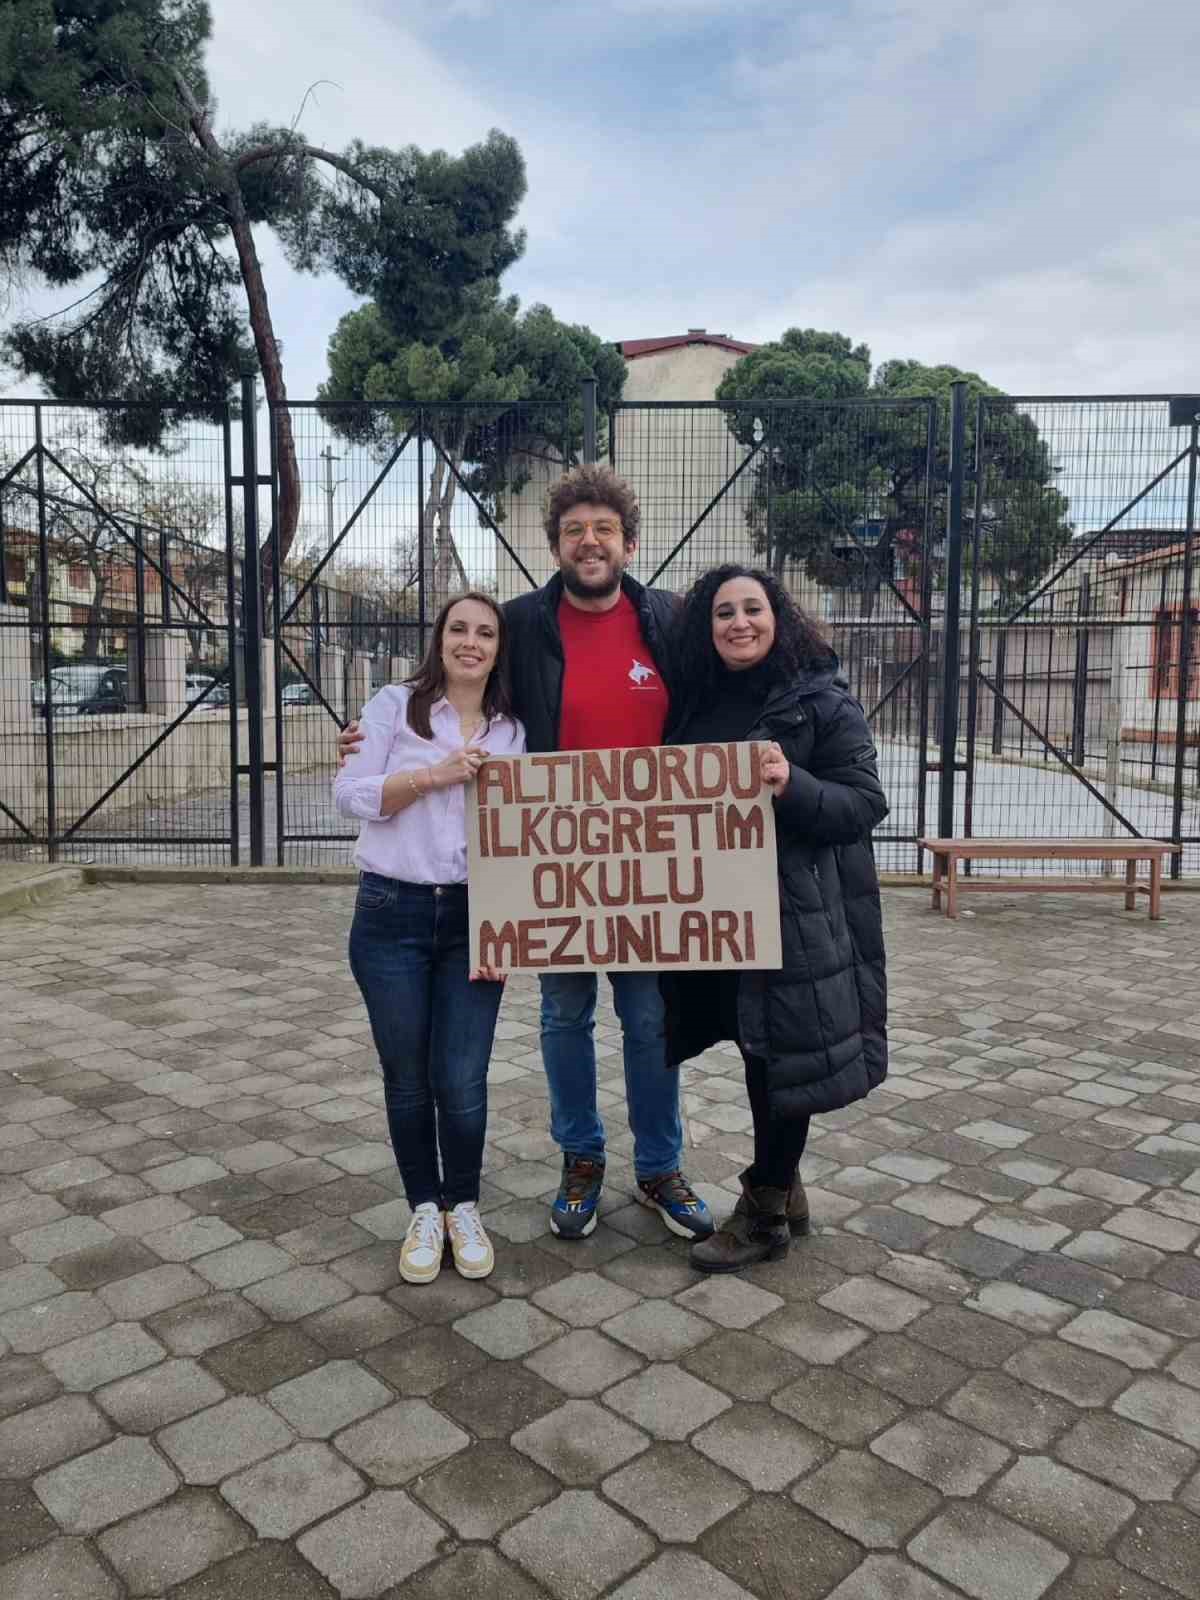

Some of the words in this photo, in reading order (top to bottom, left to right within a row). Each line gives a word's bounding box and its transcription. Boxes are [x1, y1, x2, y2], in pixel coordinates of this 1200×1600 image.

[477, 743, 761, 805] ALTINORDU
[478, 801, 764, 857] İLKÖĞRETİM
[532, 856, 704, 909] OKULU
[479, 910, 755, 968] MEZUNLARI
